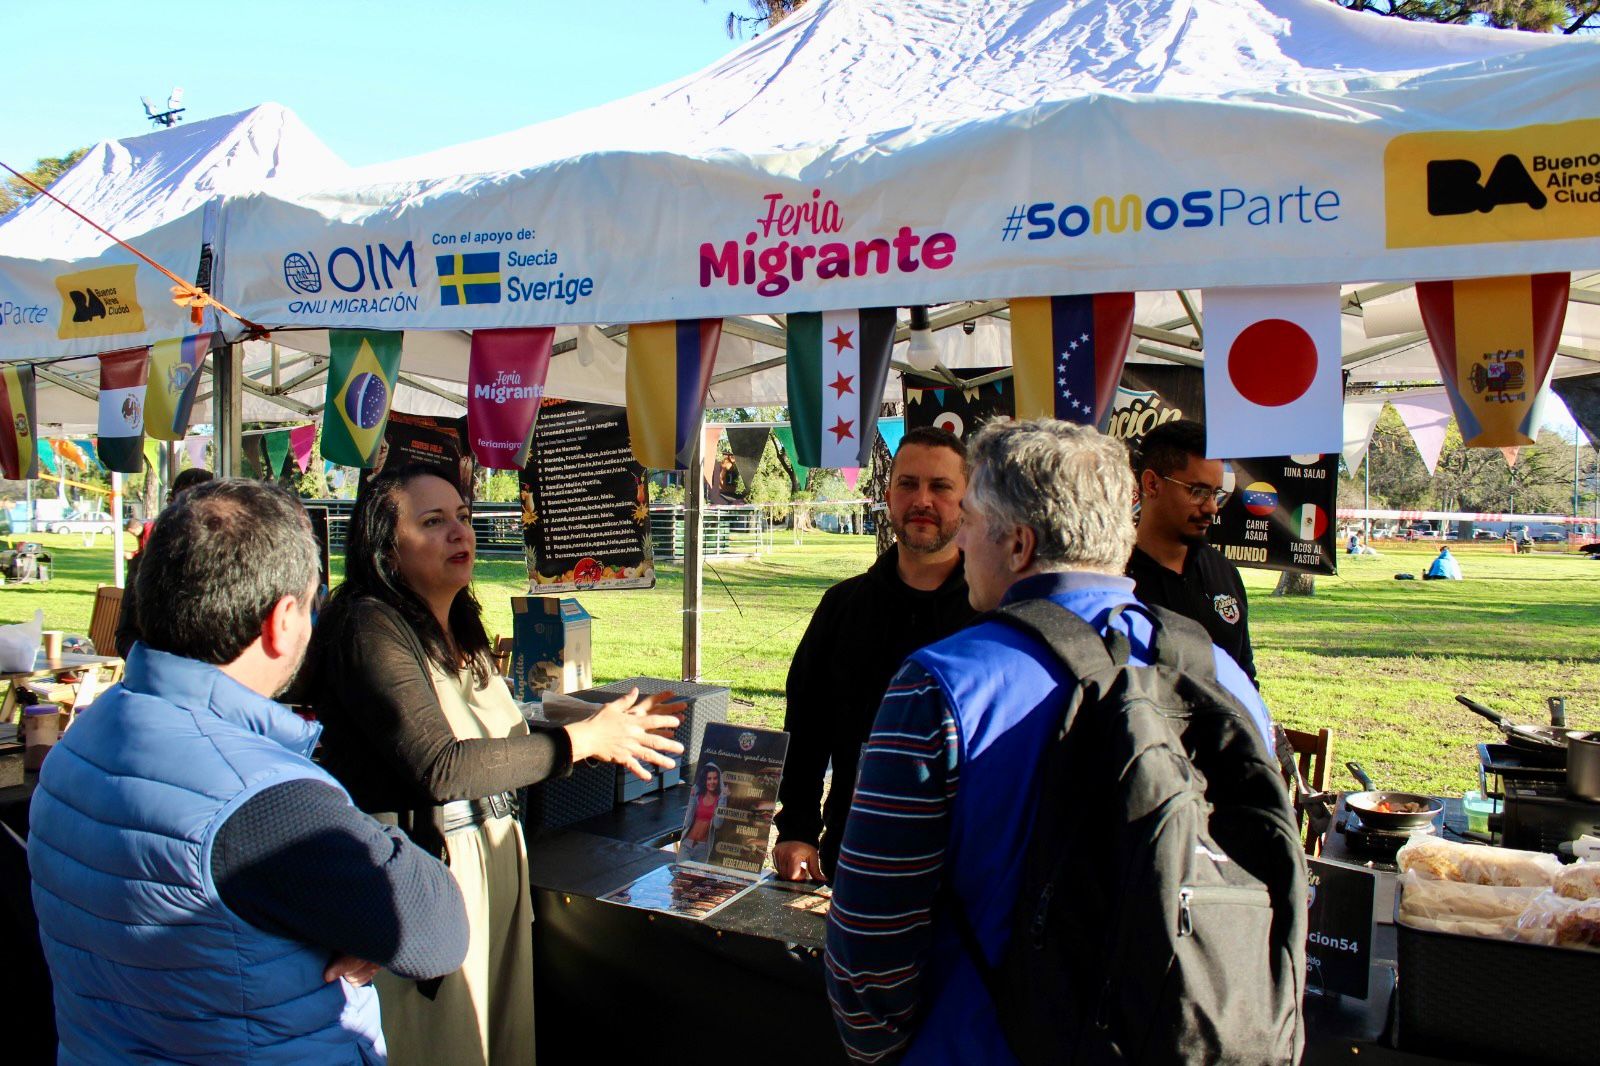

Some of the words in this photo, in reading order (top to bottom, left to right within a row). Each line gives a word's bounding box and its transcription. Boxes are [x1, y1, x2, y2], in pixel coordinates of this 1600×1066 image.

[1533, 153, 1600, 172] Bueno
[1427, 154, 1547, 216] BA
[1554, 185, 1600, 203] Ciud
[756, 188, 845, 240] Feria
[432, 233, 456, 245] Con
[460, 231, 471, 243] el
[474, 230, 513, 244] apoyo
[517, 228, 536, 240] de:
[327, 240, 417, 293] OIM
[507, 249, 558, 267] Suecia
[699, 226, 958, 298] Migrante
[95, 287, 117, 298] Buenos
[507, 272, 594, 305] Sverige
[104, 297, 119, 306] Aires
[108, 304, 130, 316] Ciudad
[288, 299, 328, 315] ONU
[330, 291, 418, 314] MIGRACIÓN
[0, 301, 48, 325] Parte
[496, 370, 521, 385] Feria
[1283, 466, 1301, 478] TUNA
[1303, 468, 1326, 479] SALAD
[1245, 519, 1269, 531] CARNE
[1244, 531, 1268, 542] ASADA
[1225, 544, 1267, 563] MUNDO
[1290, 542, 1312, 554] TACOS
[1313, 543, 1323, 554] AL
[1293, 553, 1320, 565] PASTOR
[1308, 931, 1359, 954] cion54
